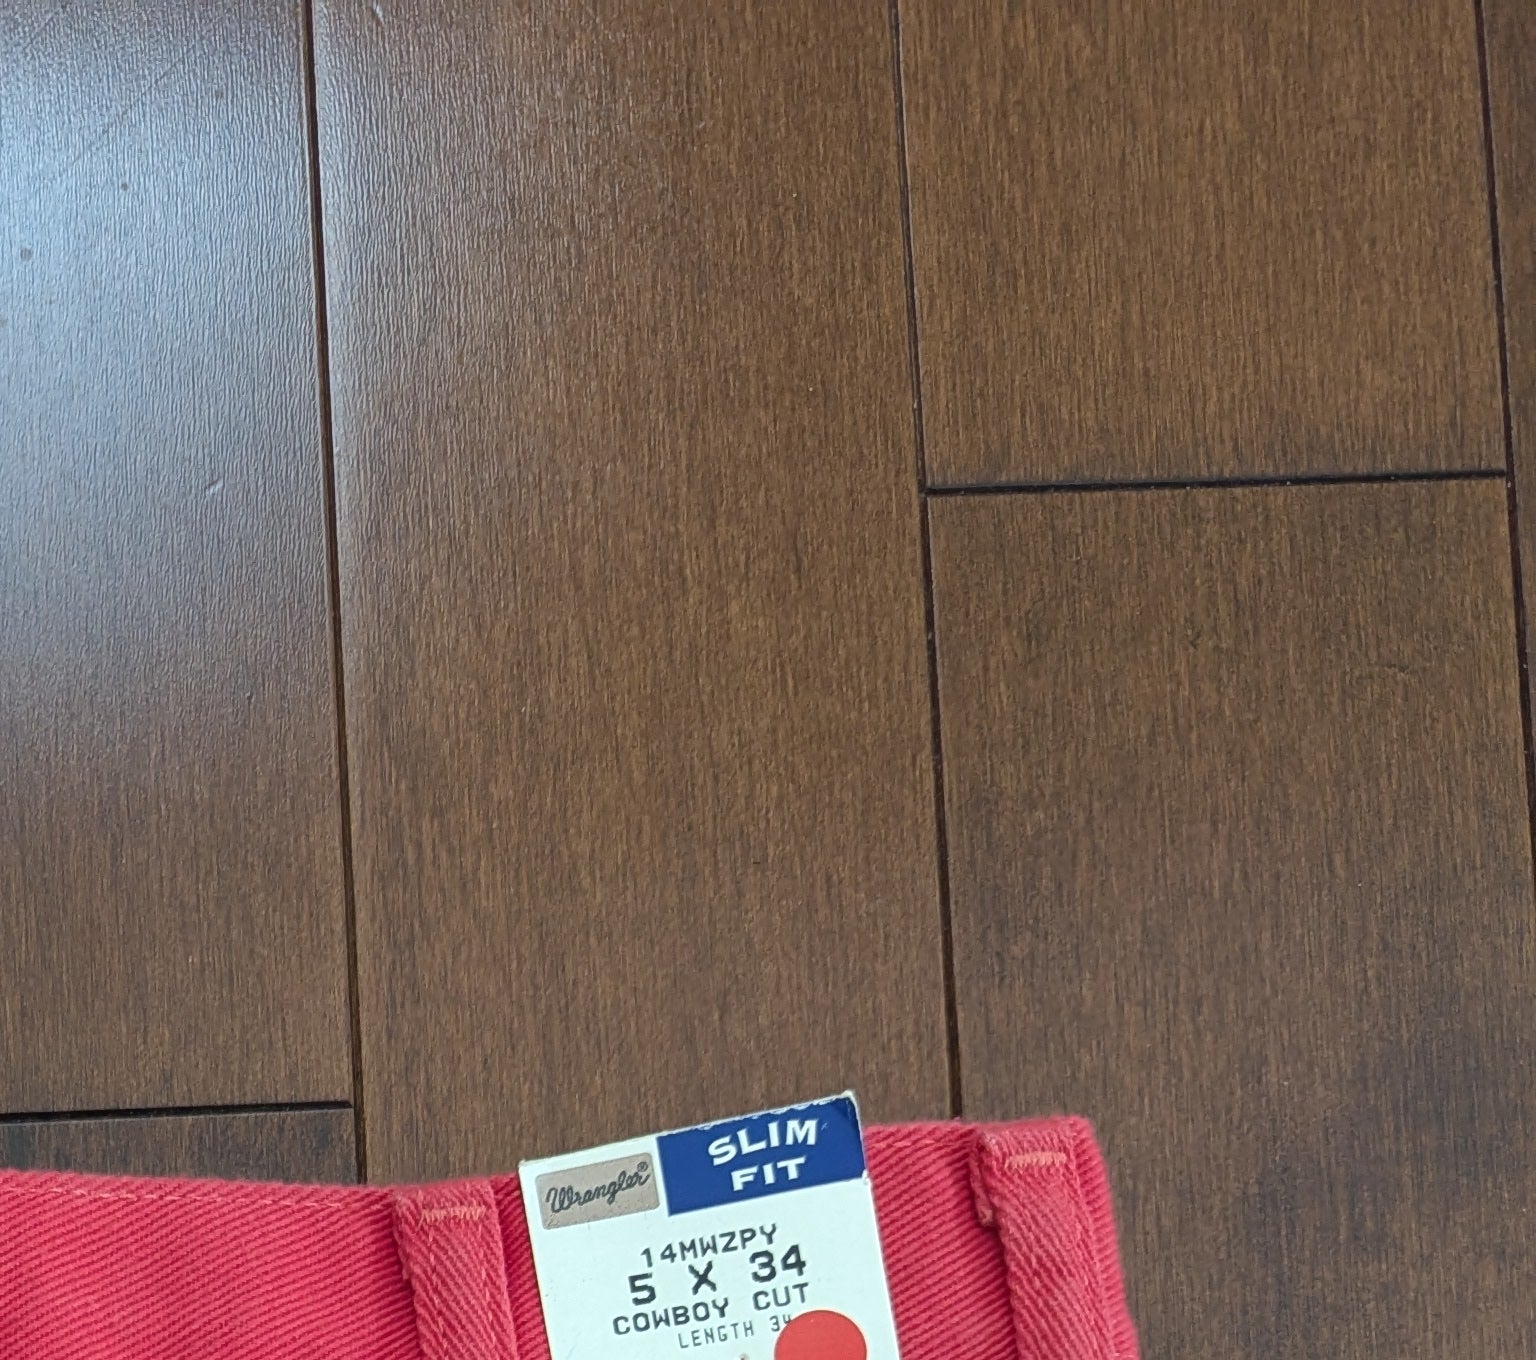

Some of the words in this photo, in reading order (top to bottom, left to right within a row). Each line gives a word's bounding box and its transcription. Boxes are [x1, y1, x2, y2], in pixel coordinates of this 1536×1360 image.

[708, 1118, 819, 1166] SLIM
[730, 1155, 806, 1191] FIT
[640, 1223, 777, 1268] 14MWZPY
[628, 1272, 657, 1306] 5
[688, 1260, 717, 1296] X
[749, 1244, 807, 1283] 34
[612, 1297, 729, 1336] COWBOY
[752, 1282, 810, 1311] CUT
[677, 1320, 755, 1349] LENGTH
